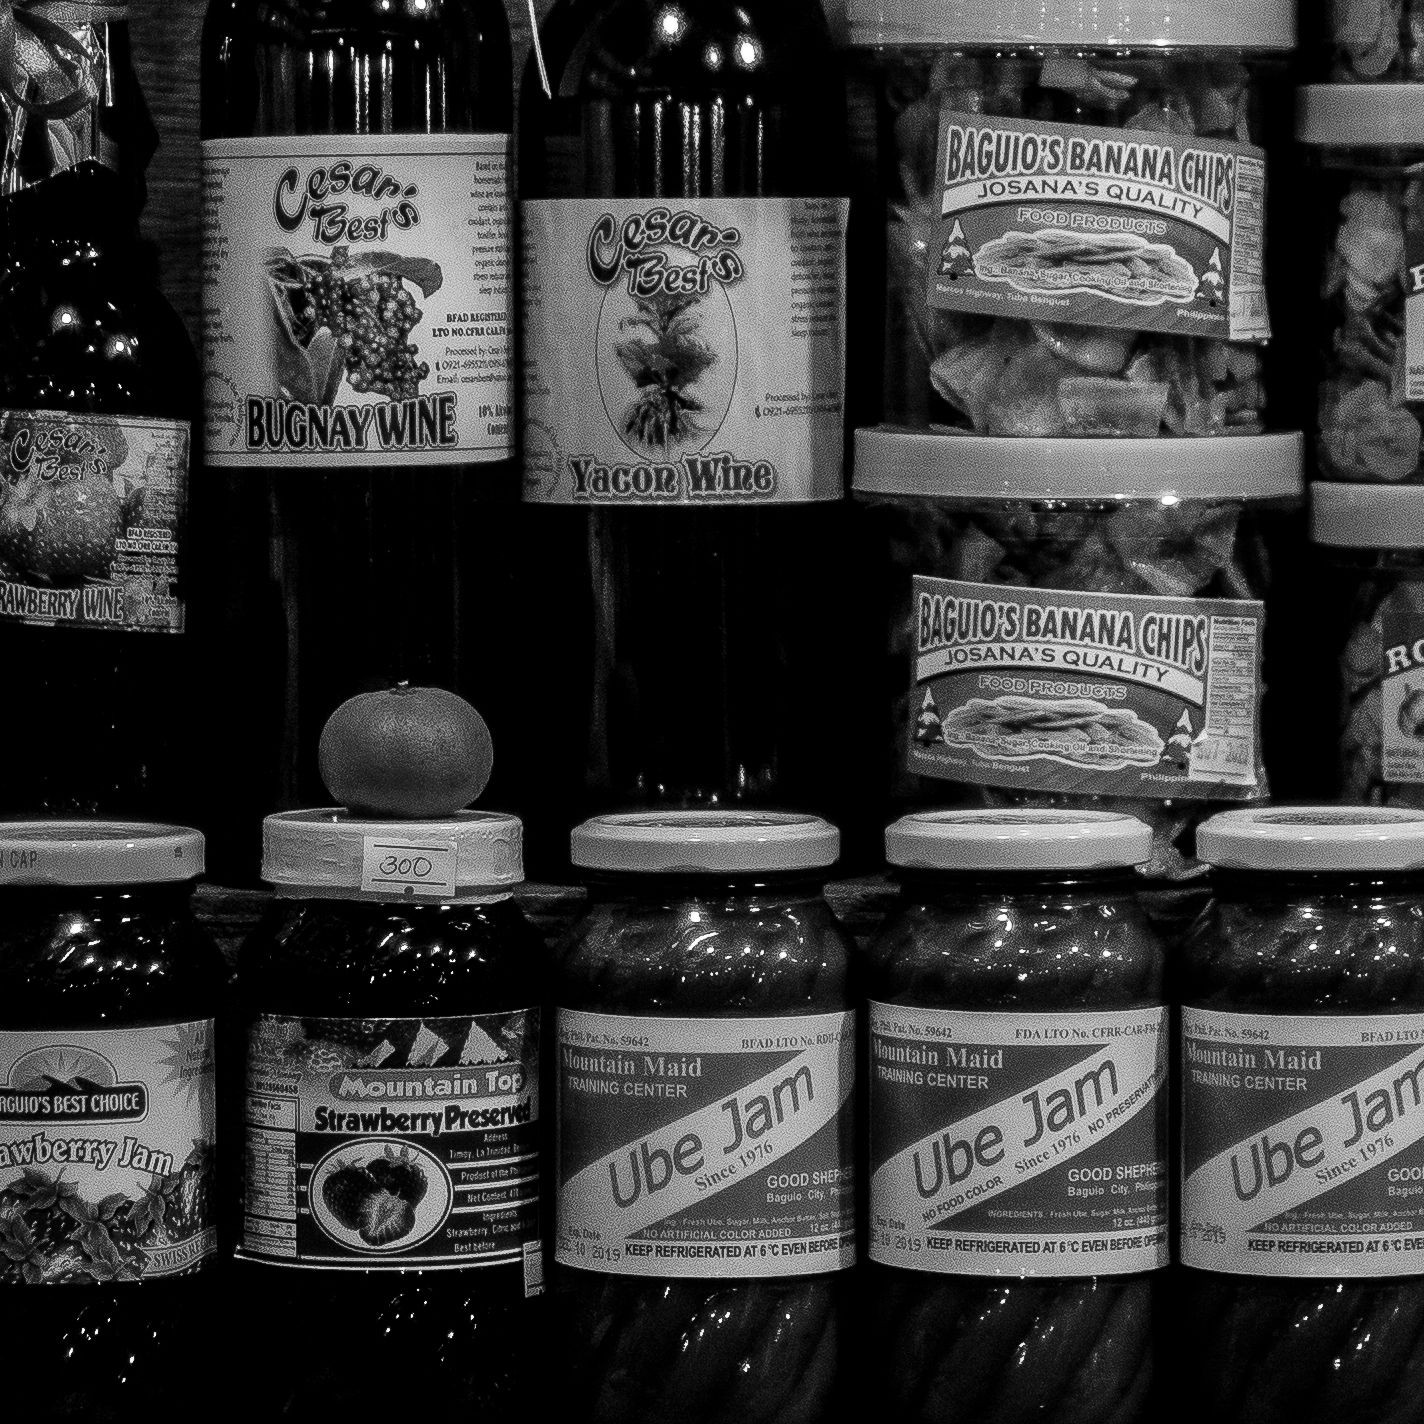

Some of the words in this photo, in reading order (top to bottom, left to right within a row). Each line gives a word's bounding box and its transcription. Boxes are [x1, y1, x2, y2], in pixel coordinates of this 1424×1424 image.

[945, 125, 1064, 184] BAGUIO'S
[1067, 138, 1176, 187] BANANA
[1179, 149, 1234, 213] CHIPS
[978, 180, 1100, 199] JOSANA'S
[1106, 184, 1204, 219] QUALITY
[1017, 207, 1069, 226] FOOD
[1070, 210, 1167, 235] PRODUCTS
[246, 397, 372, 453] BUGNAY
[373, 392, 460, 450] WINE
[570, 454, 679, 499] Yacon
[684, 452, 777, 496] Wine
[83, 583, 125, 622] WINE
[918, 592, 1019, 652] BAGUIO'S
[1024, 605, 1136, 653] BANANA
[1139, 613, 1207, 676] CHIPS
[944, 647, 1056, 666] JOSANA'S
[1062, 651, 1171, 683] QUALITY
[978, 676, 1026, 693] FOOD
[1028, 678, 1129, 701] PRODUCTS
[10, 849, 38, 870] CAP
[379, 855, 433, 878] 300
[946, 1046, 1003, 1069] Maid
[1265, 1048, 1322, 1071] Maid
[337, 1074, 478, 1098] Mountain
[485, 1070, 523, 1094] Top
[568, 1076, 620, 1095] TRAINING
[624, 1081, 688, 1098] CENTER
[877, 1064, 924, 1086] TRAINING
[927, 1073, 989, 1090] CENTER
[1244, 1075, 1308, 1092] CENTER
[54, 1094, 88, 1113] BEST
[91, 1092, 140, 1112] CHOICE
[314, 1104, 443, 1137] Strawberry
[913, 1125, 1005, 1200] Ube
[1022, 1058, 1119, 1148] Jam
[608, 1132, 705, 1209] Ube
[721, 1064, 815, 1155] Jam
[117, 1136, 174, 1176] Jam
[695, 1164, 737, 1193] Since
[741, 1139, 774, 1169] 1976
[1230, 1125, 1326, 1202] Ube
[767, 1172, 809, 1188] GOOD
[625, 1243, 653, 1258] KEEP
[655, 1243, 741, 1259] REFRIGERATED
[743, 1243, 758, 1258] AT
[781, 1240, 807, 1256] EVEN
